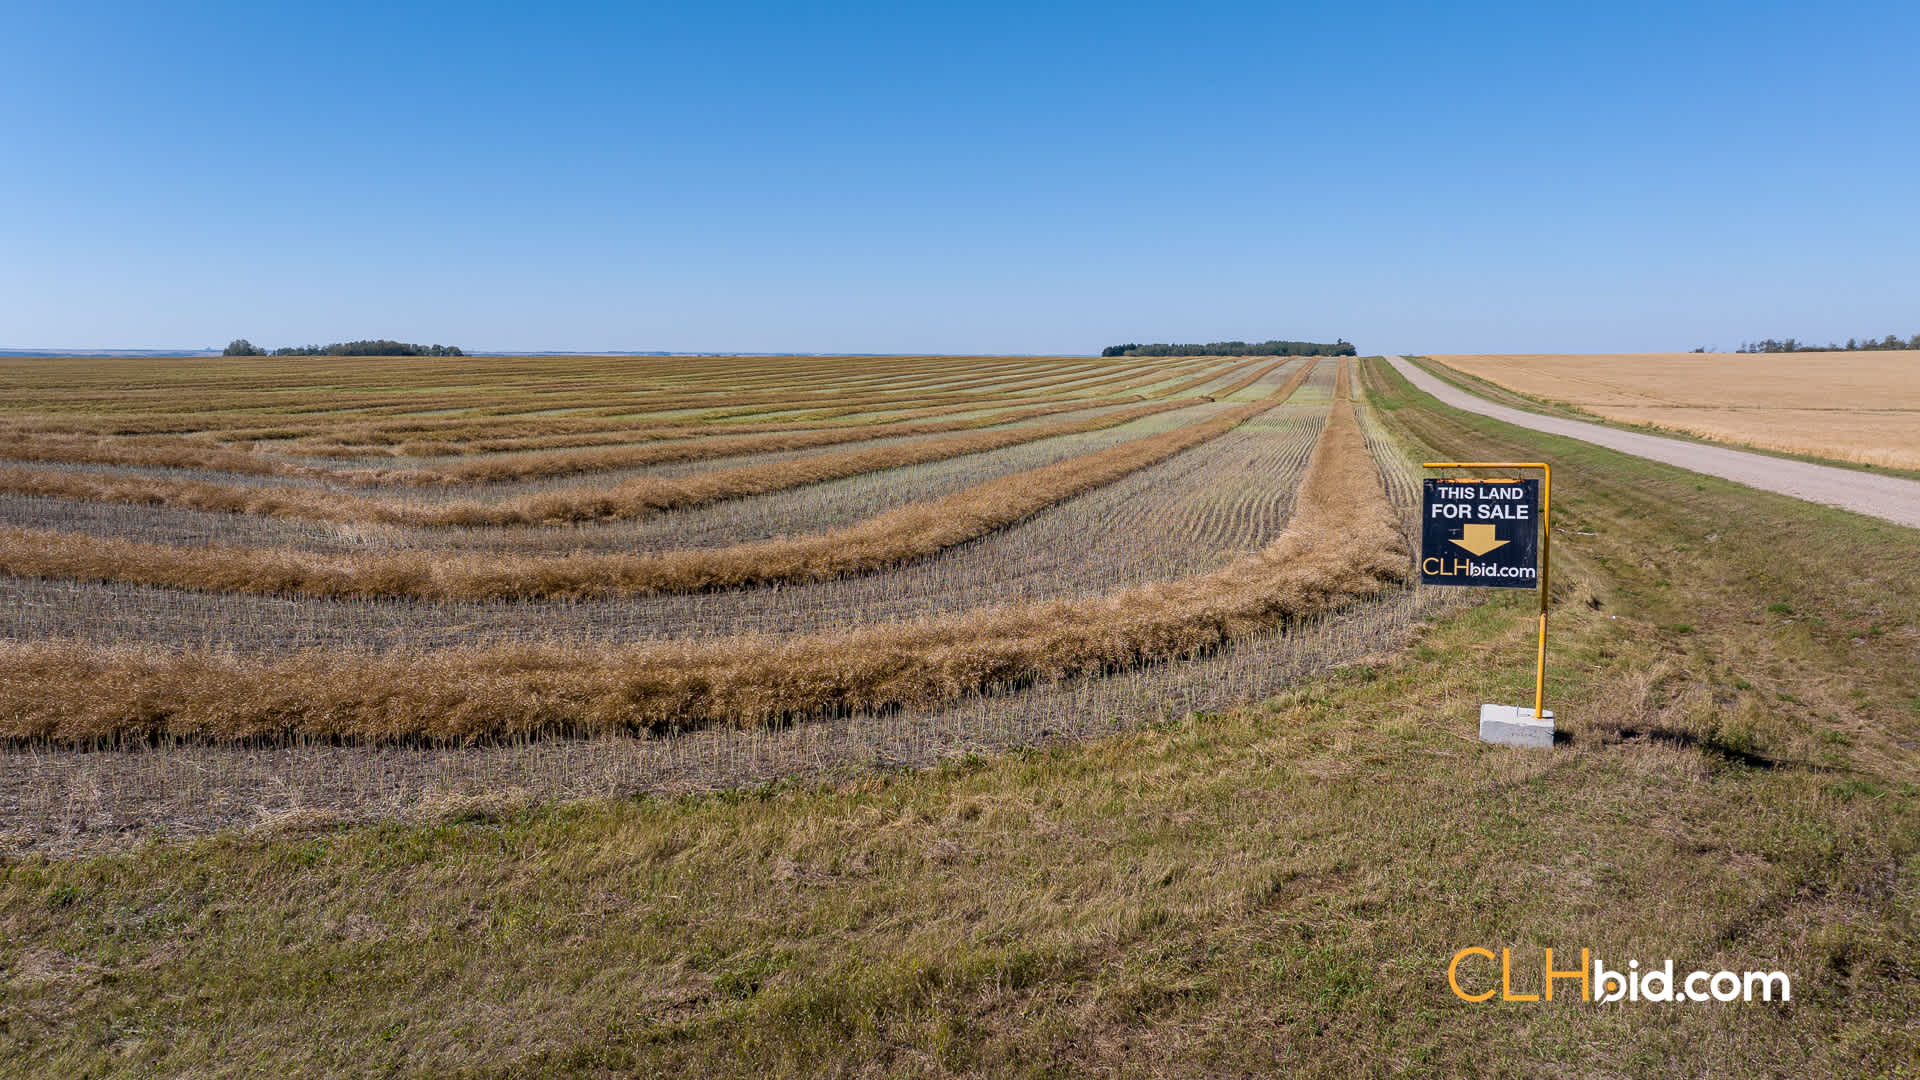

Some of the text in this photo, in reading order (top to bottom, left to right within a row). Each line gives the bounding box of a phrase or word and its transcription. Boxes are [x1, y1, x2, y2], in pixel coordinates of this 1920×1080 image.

[1438, 487, 1523, 500] THIS LAND
[1432, 504, 1529, 520] FOR SALE
[1422, 557, 1536, 578] CLHbid.com
